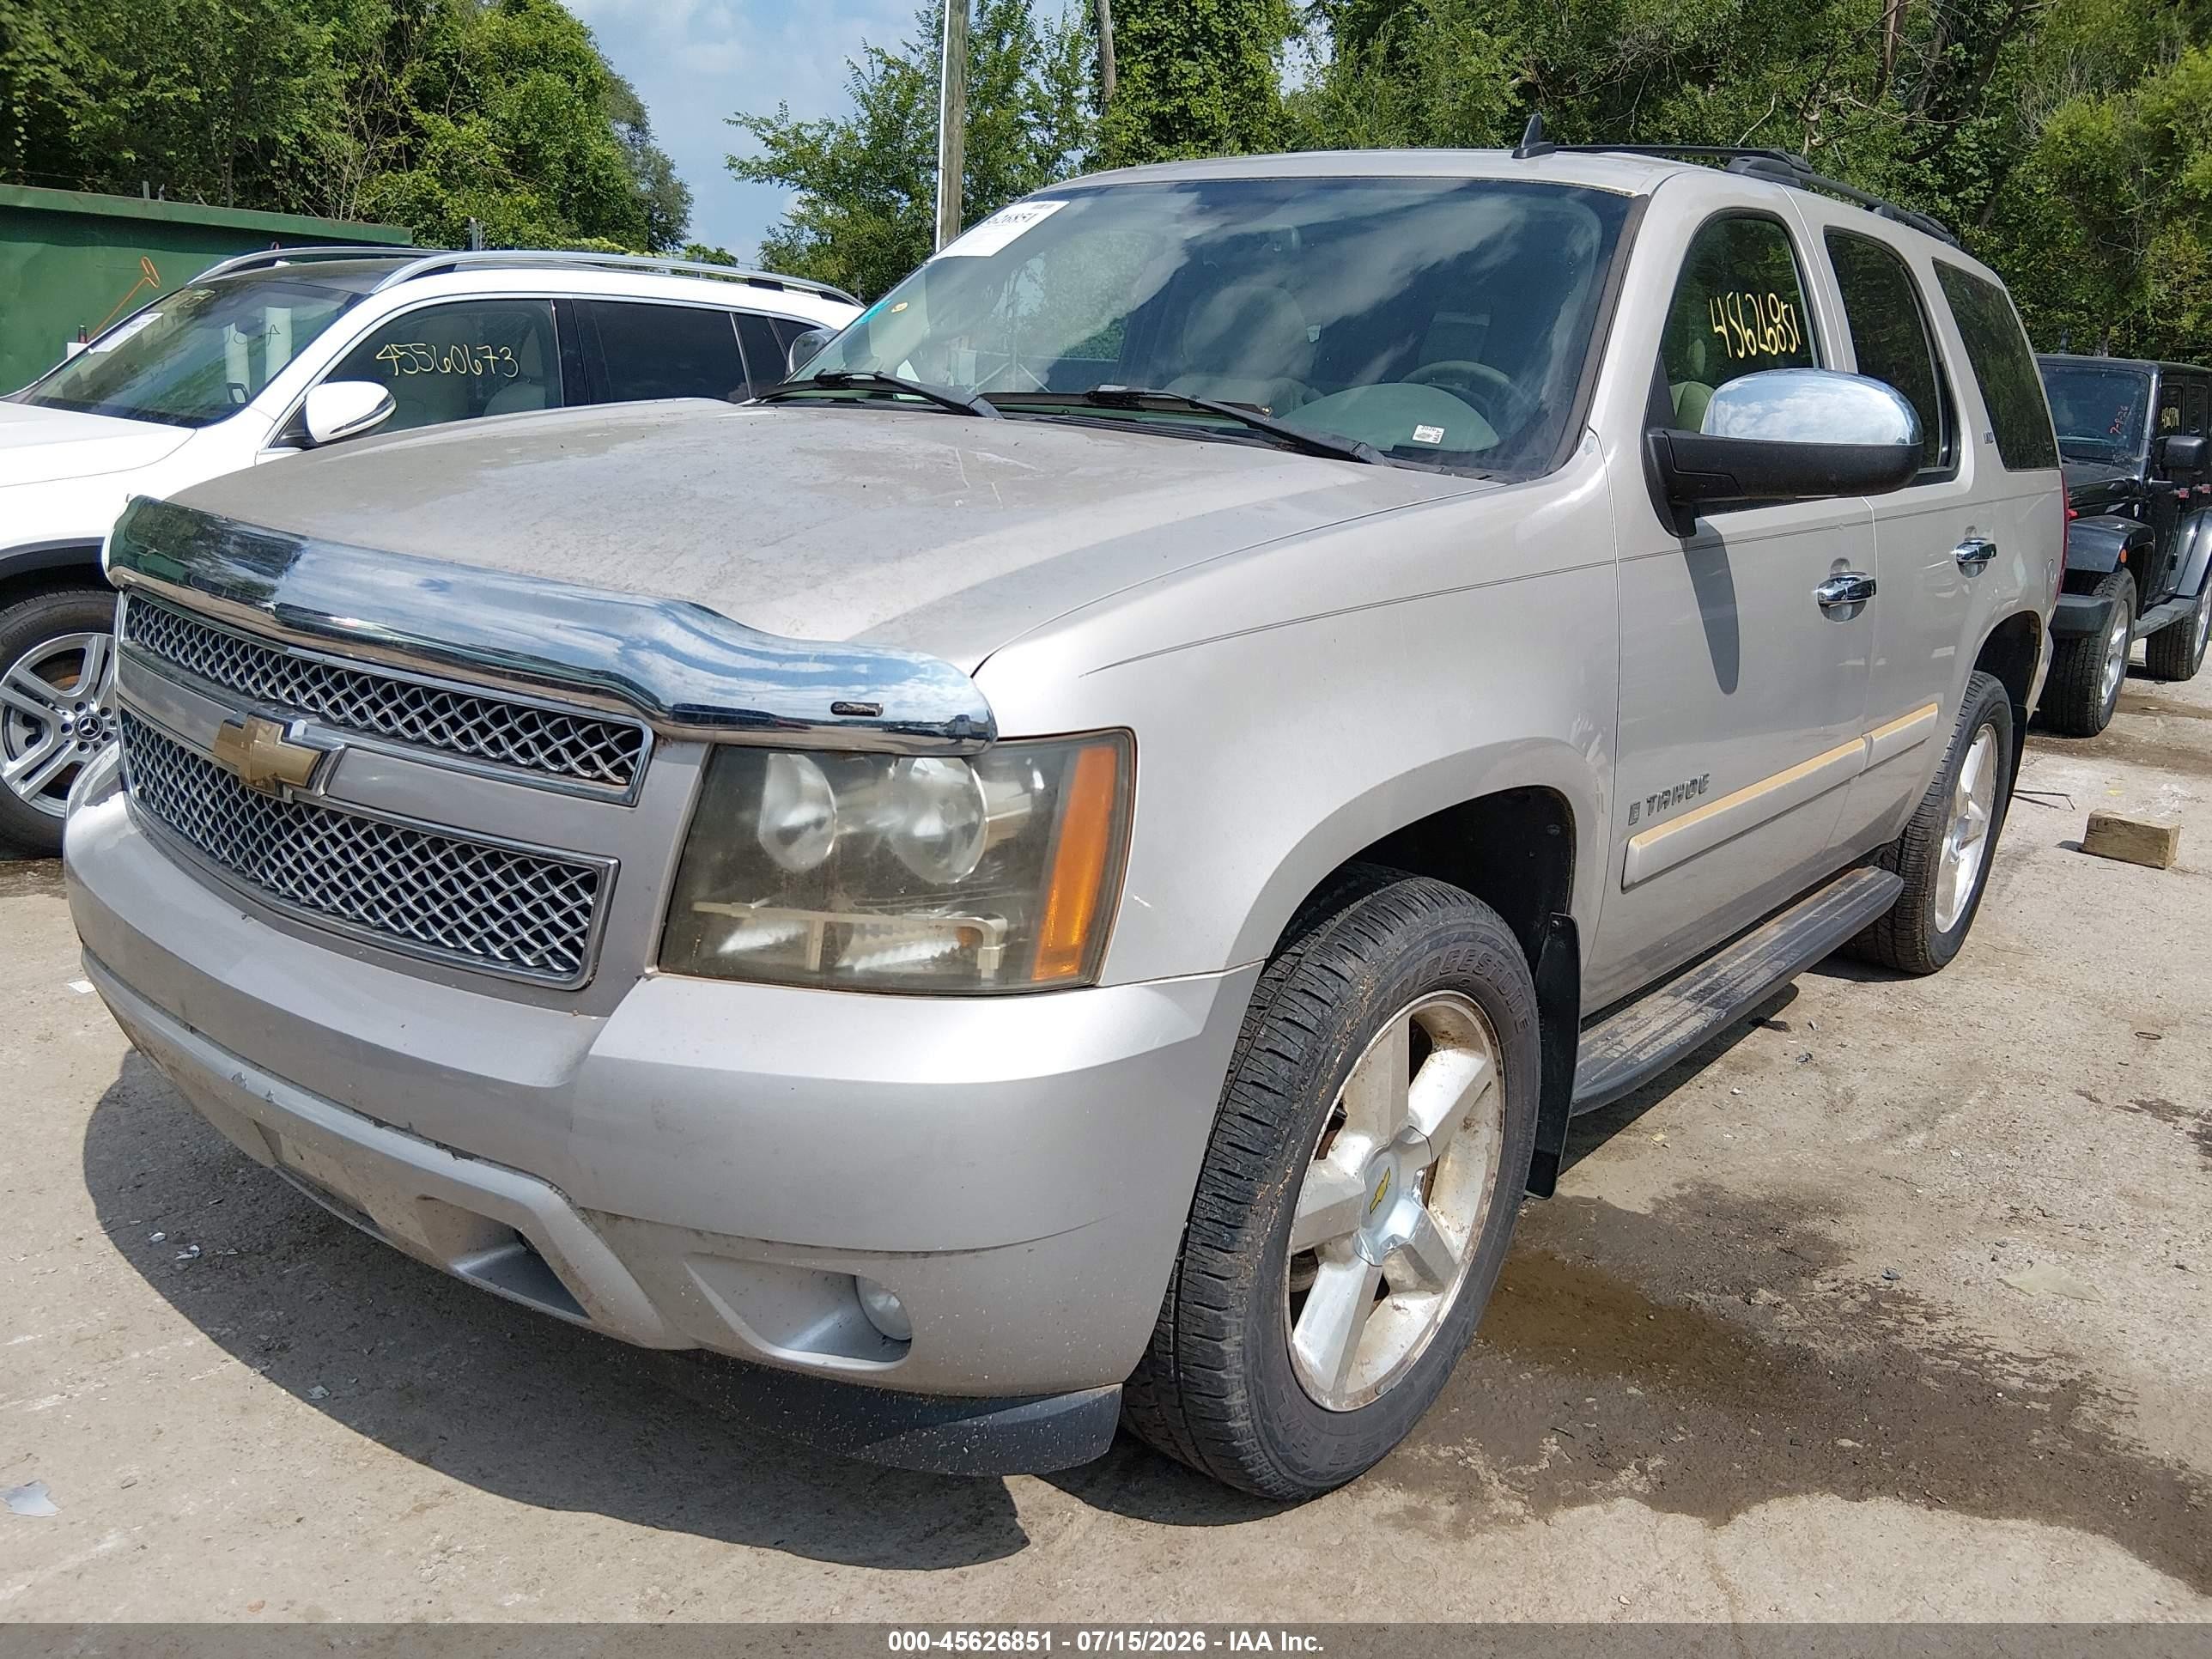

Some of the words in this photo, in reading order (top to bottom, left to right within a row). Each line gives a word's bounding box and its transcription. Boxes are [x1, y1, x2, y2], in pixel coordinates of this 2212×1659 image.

[1709, 291, 1802, 359] 45626851
[375, 343, 520, 378] 45560673
[1646, 773, 1711, 817] TAHOE
